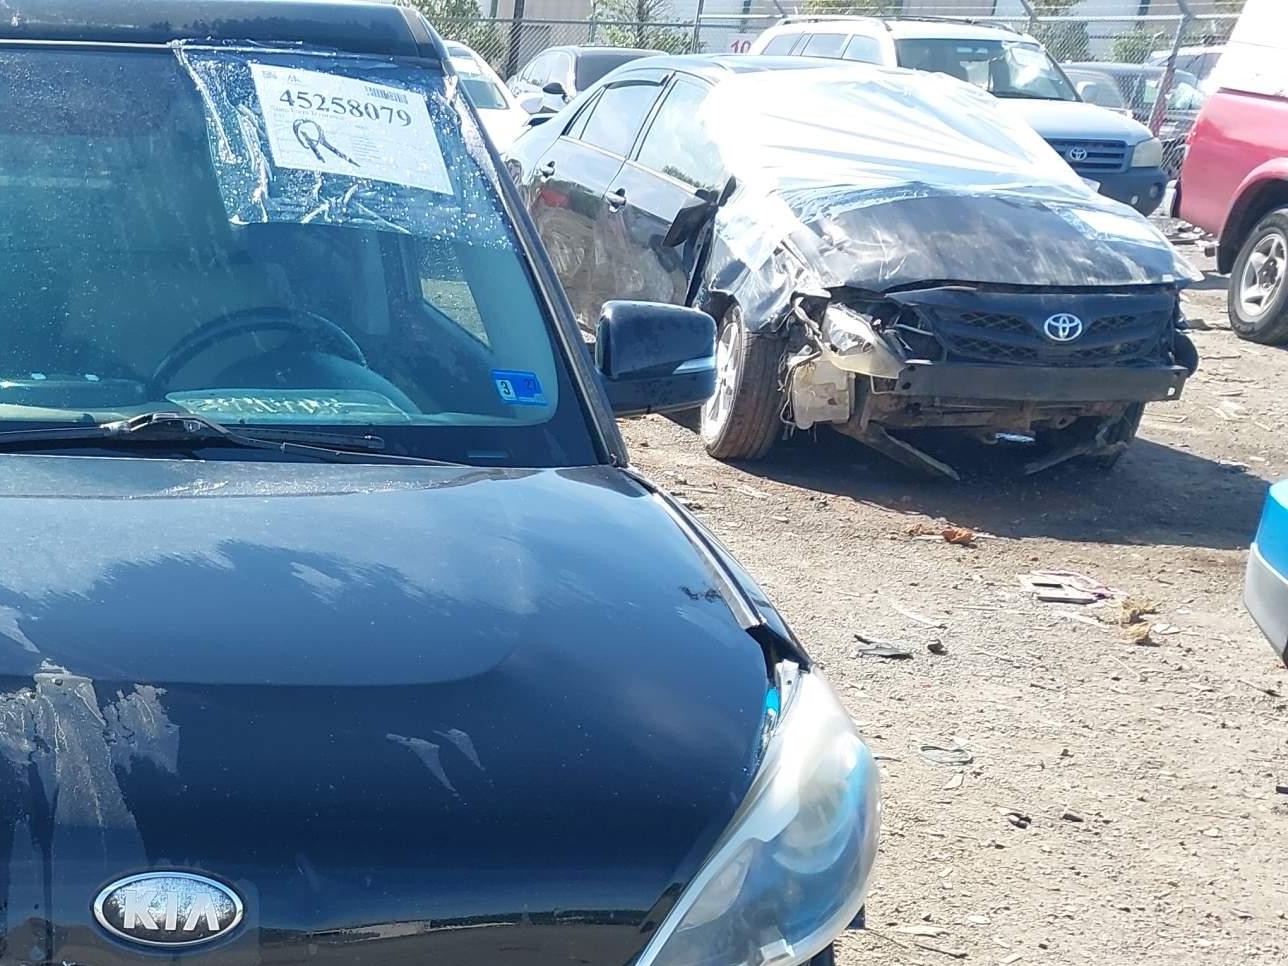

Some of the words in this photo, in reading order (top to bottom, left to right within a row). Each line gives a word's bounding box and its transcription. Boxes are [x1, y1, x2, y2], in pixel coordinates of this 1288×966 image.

[279, 89, 412, 126] 45258079
[500, 380, 511, 396] 3
[123, 889, 220, 930] KIA
